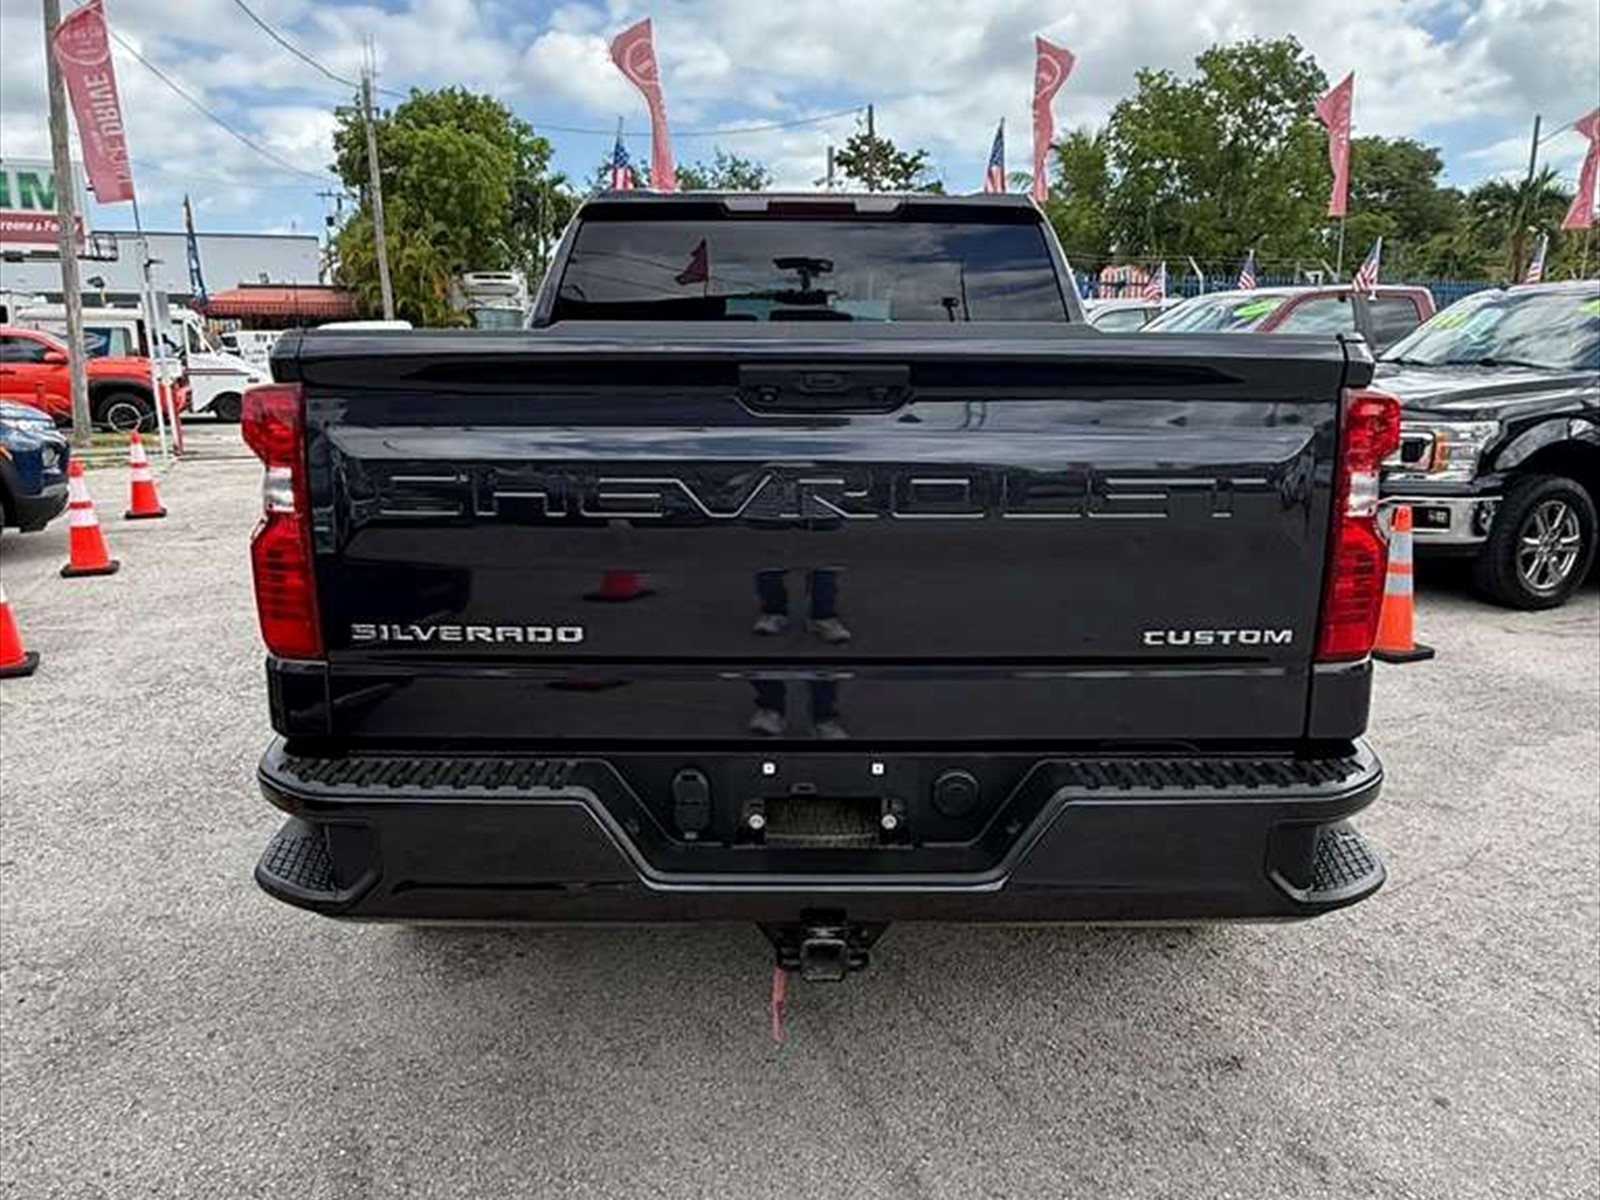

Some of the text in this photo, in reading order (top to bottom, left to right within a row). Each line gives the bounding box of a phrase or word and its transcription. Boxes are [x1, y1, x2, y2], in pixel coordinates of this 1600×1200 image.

[84, 72, 124, 135] DRIVE
[374, 468, 1269, 518] CHEVROLET
[350, 623, 584, 643] SILVERADO
[1143, 629, 1294, 646] CUSTOM
